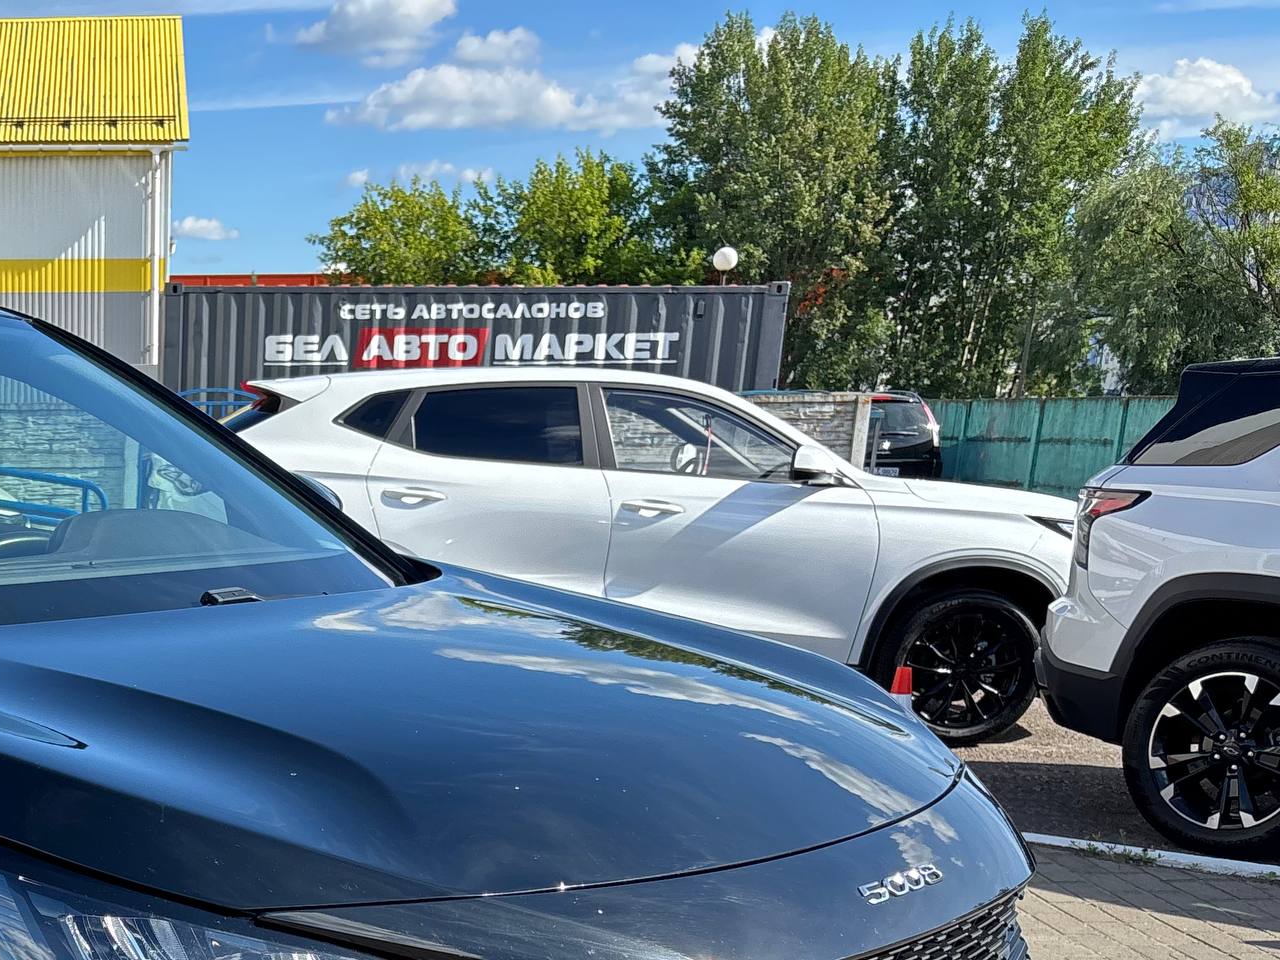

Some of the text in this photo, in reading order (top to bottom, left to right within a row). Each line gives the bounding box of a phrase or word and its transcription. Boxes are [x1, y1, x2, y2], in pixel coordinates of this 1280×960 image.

[340, 302, 605, 320] СЕТЬ АВТОСАЛОНОВ
[265, 332, 680, 361] БЕЛ АВТО МАРКЕТ
[857, 864, 943, 904] 5008
